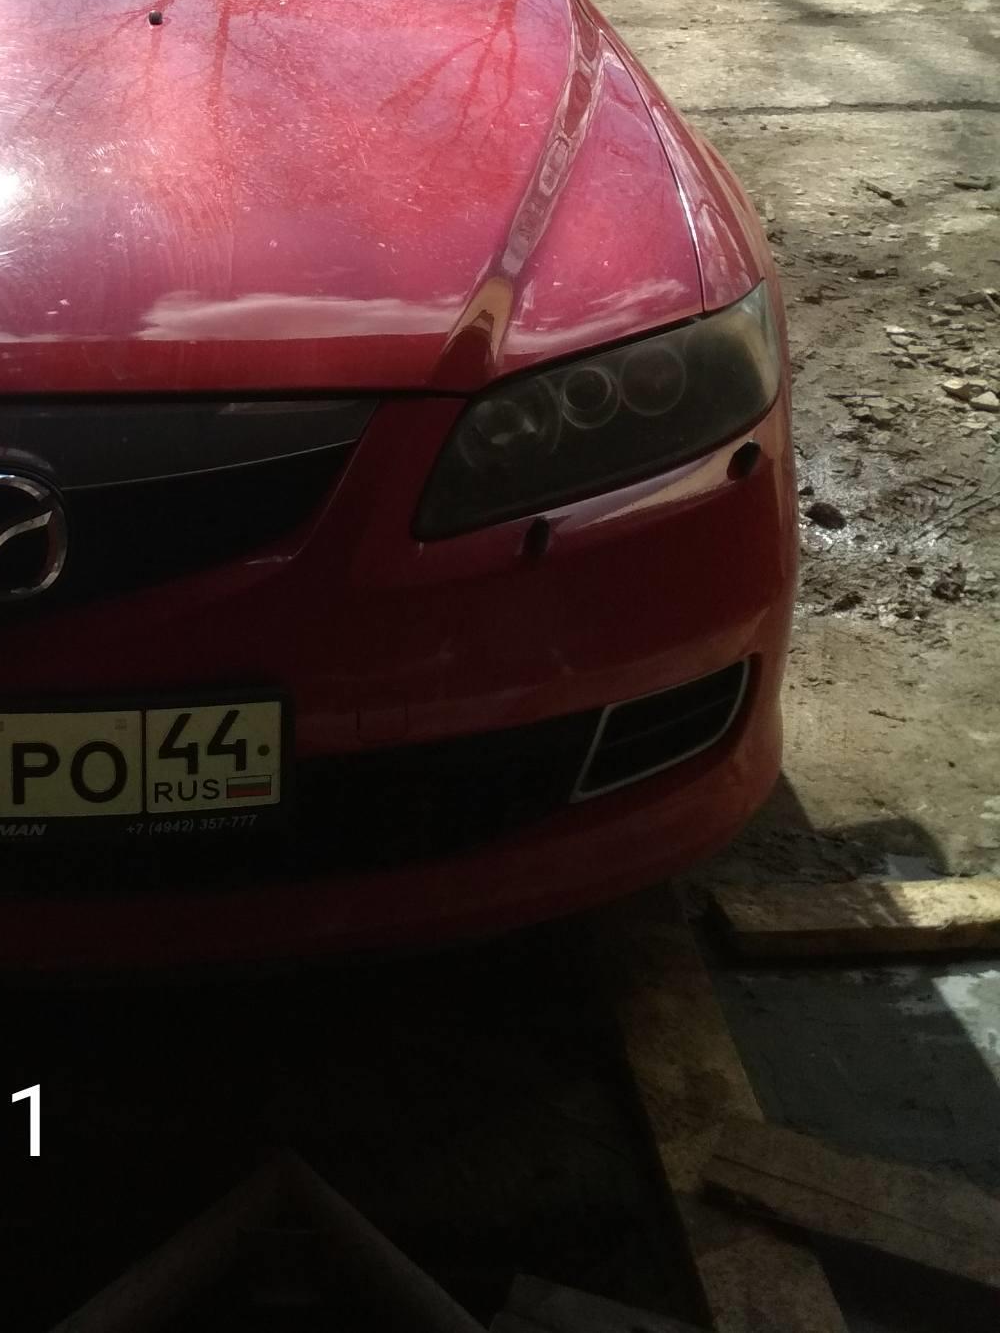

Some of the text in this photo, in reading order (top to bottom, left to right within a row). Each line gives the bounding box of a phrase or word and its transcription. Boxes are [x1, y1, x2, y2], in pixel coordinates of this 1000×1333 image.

[159, 710, 247, 775] 44
[154, 779, 220, 803] RUS
[198, 813, 259, 831] 357-777
